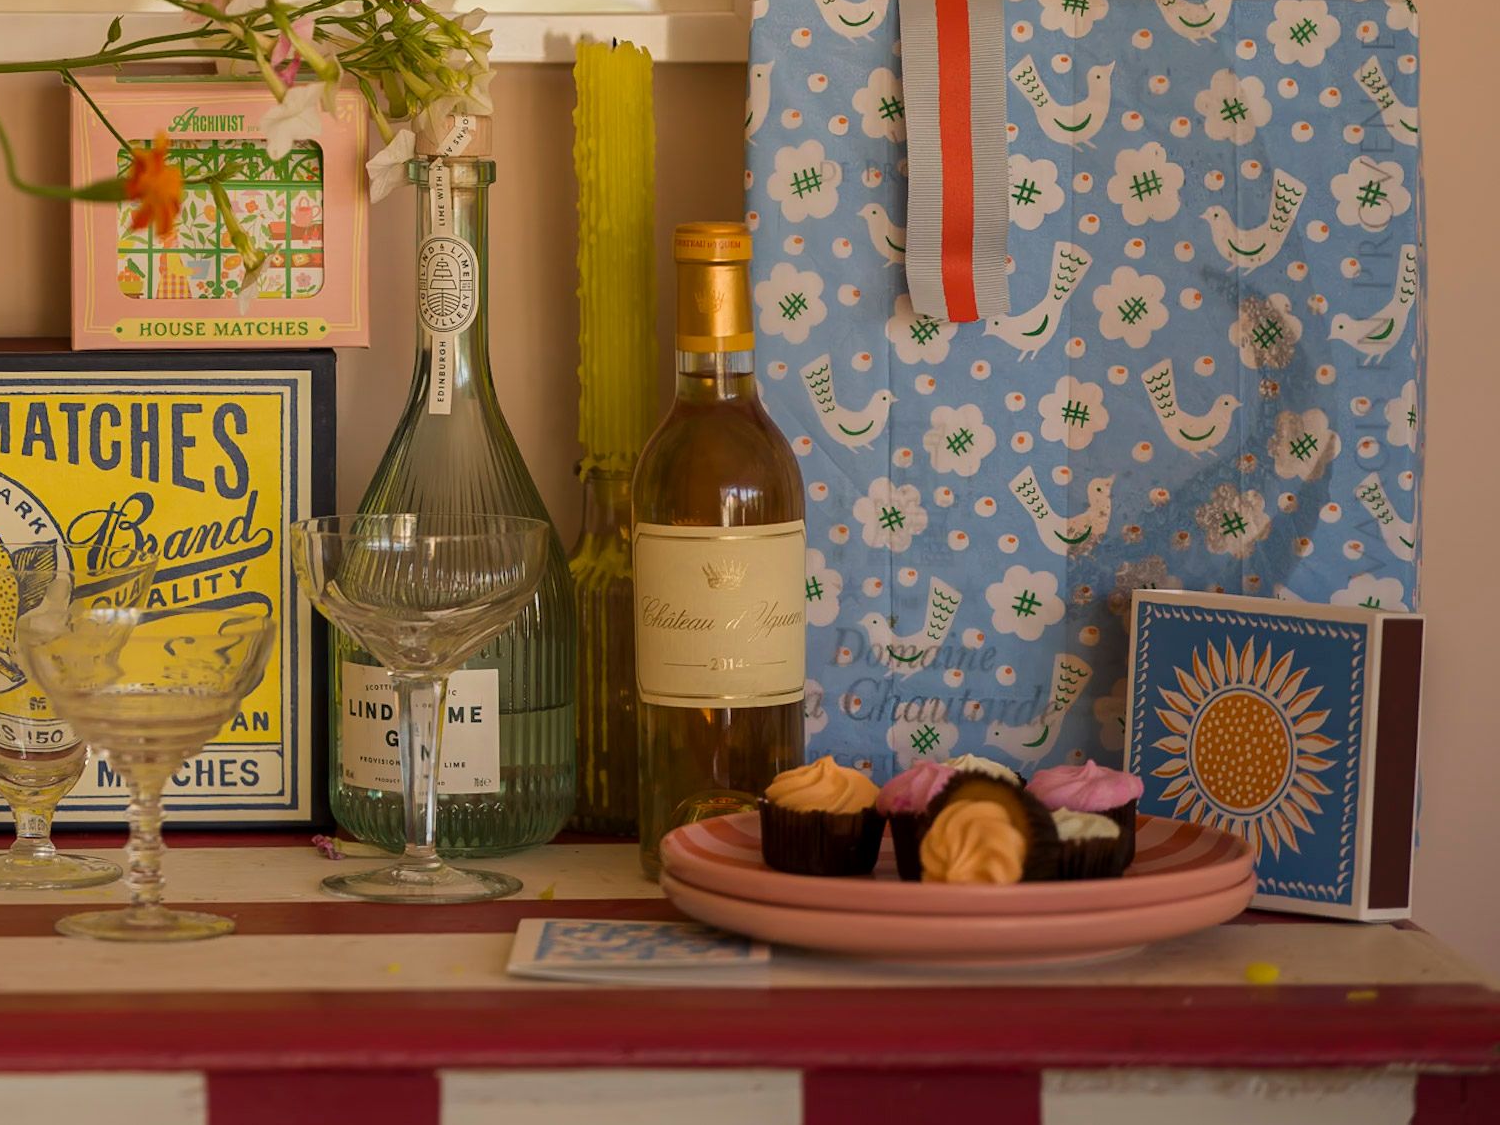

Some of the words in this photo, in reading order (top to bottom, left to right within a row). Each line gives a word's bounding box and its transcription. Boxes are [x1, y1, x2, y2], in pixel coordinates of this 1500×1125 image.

[167, 106, 245, 132] ARCHIVIST
[421, 246, 435, 277] LIND
[450, 245, 470, 277] LIME
[420, 292, 470, 327] DISTILLERY
[139, 322, 206, 337] HOUSE
[213, 321, 309, 336] MATCHES
[437, 340, 446, 403] EDINBURGH
[66, 491, 273, 577] Brand
[830, 626, 999, 673] Domaine
[349, 698, 394, 721] LIND
[448, 705, 483, 724] ME
[97, 759, 261, 788] MCHES
[359, 756, 401, 766] PROVISION
